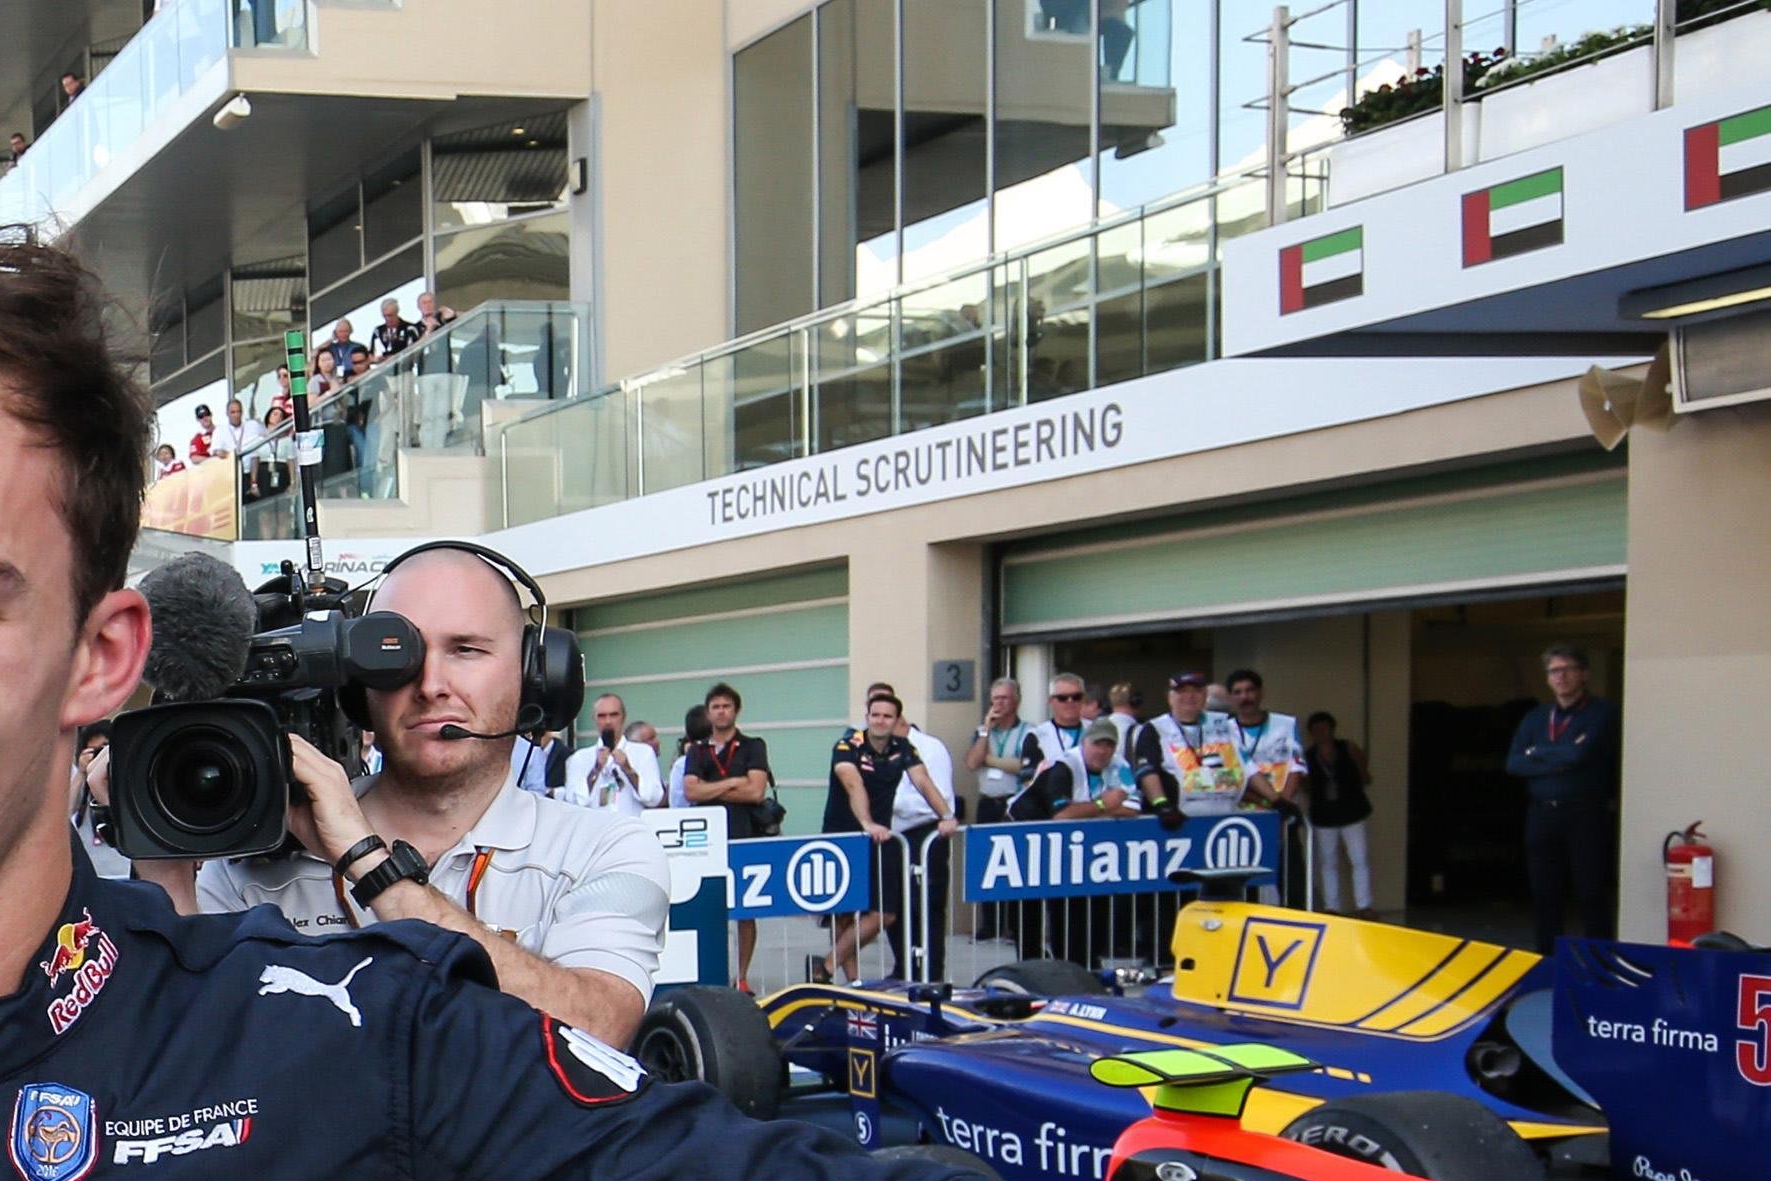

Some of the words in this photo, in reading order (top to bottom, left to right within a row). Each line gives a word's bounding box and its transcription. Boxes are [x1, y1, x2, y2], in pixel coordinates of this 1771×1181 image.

[707, 464, 847, 525] TECHNICAL
[856, 402, 1124, 498] SCRUTINEERING
[946, 663, 962, 693] 3
[981, 829, 1193, 890] Allianz
[292, 916, 310, 928] lex
[1256, 934, 1304, 989] Y
[1587, 1014, 1646, 1043] terra
[1652, 1018, 1719, 1053] firma
[104, 1118, 165, 1137] EQUIPE
[169, 1113, 190, 1131] DE
[194, 1099, 259, 1125] FRANCE
[936, 1106, 1024, 1166] terra
[113, 1122, 240, 1165] FFSA
